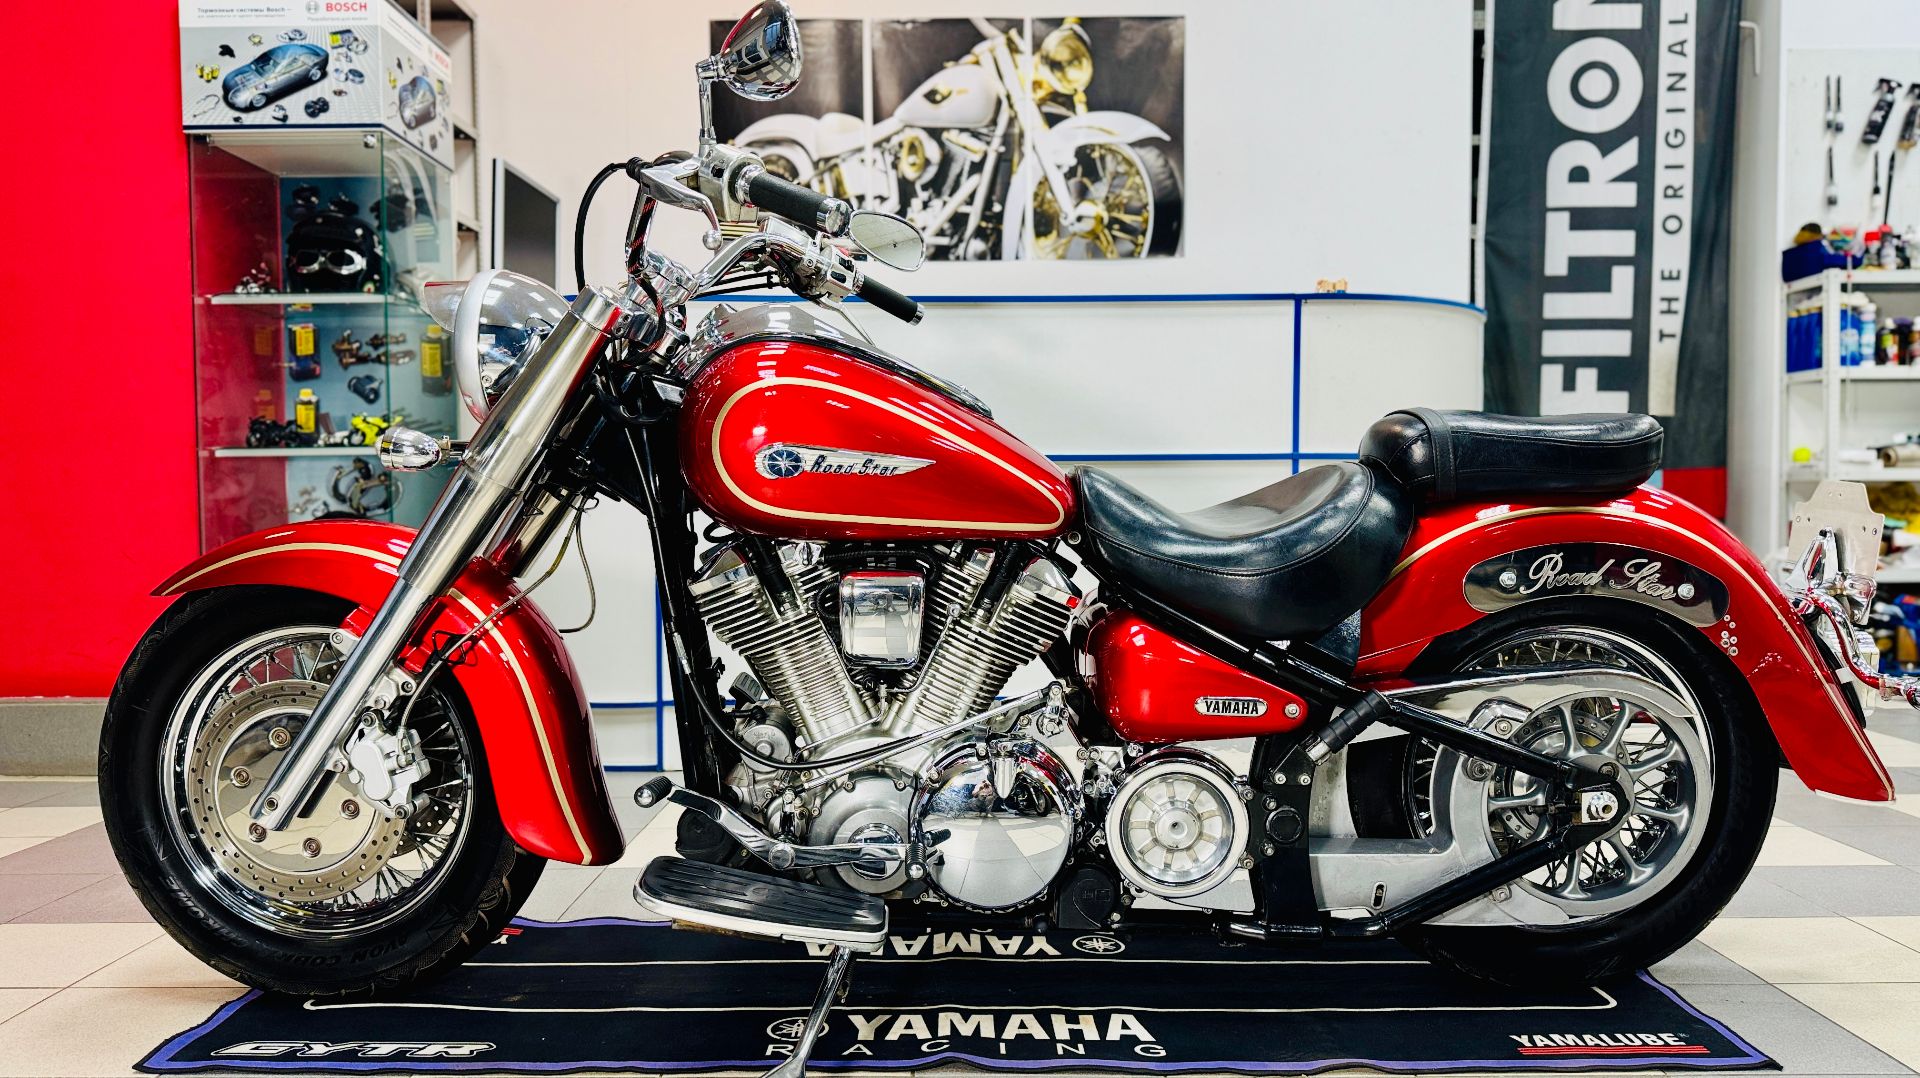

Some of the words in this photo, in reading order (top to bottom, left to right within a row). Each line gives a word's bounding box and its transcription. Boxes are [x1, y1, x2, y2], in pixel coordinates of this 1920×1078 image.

[325, 2, 368, 12] BOSCH
[1662, 12, 1689, 234] ORIGINAL
[1659, 268, 1681, 342] THE
[809, 454, 856, 474] Road
[857, 458, 899, 476] Star
[1519, 552, 1615, 594] Road
[1609, 558, 1677, 600] Star
[1204, 700, 1259, 715] YAMAHA
[805, 931, 1062, 957] YAMAA
[847, 1012, 1157, 1042] YAMAHA
[211, 1041, 496, 1057] GYTR
[765, 1039, 1167, 1057] RACING
[1510, 1033, 1687, 1047] YAMALUBE
